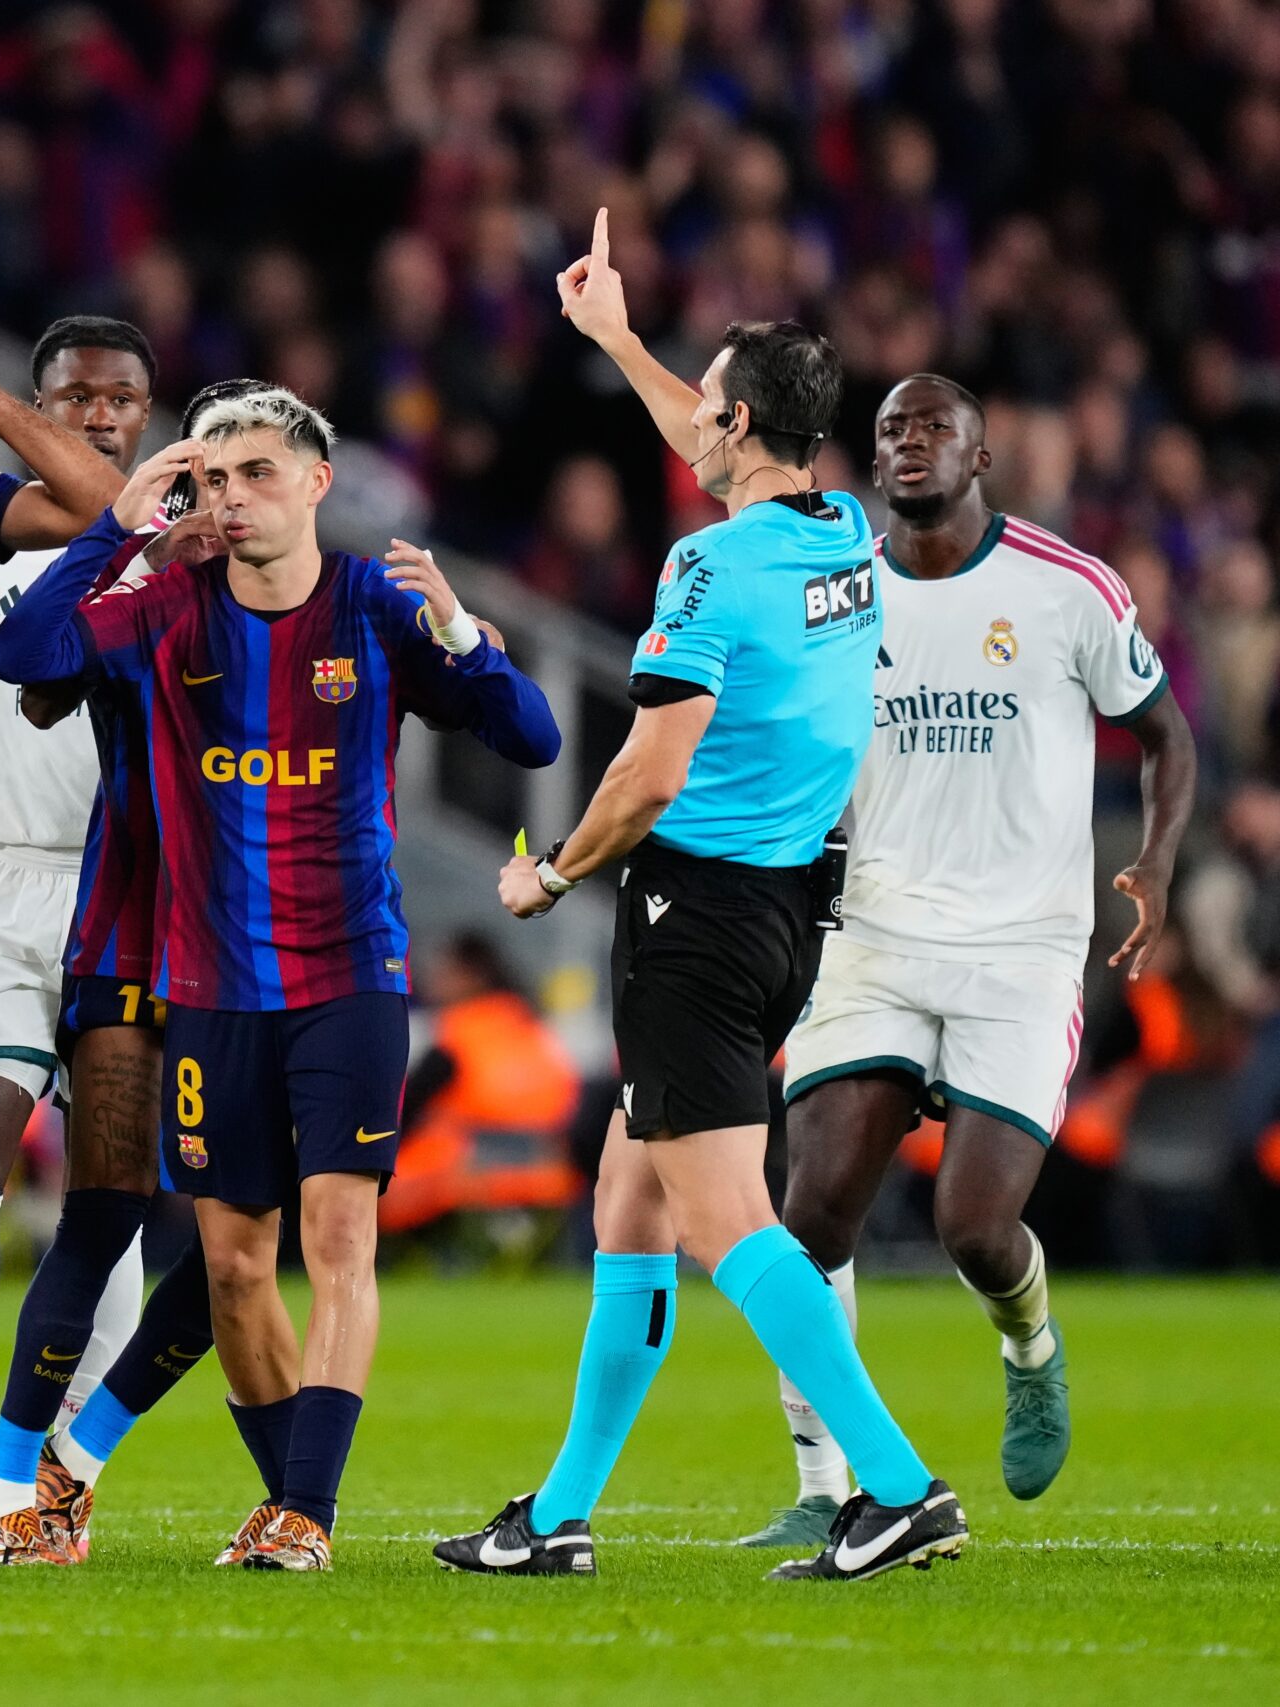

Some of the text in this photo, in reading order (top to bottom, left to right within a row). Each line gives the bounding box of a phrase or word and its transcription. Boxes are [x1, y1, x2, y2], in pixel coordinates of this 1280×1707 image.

[806, 568, 871, 620] BKT
[848, 610, 877, 634] TIRES
[873, 684, 1019, 728] Emirates
[900, 725, 993, 754] LY BETTER
[201, 746, 336, 786] GOLF
[177, 1057, 204, 1127] 8
